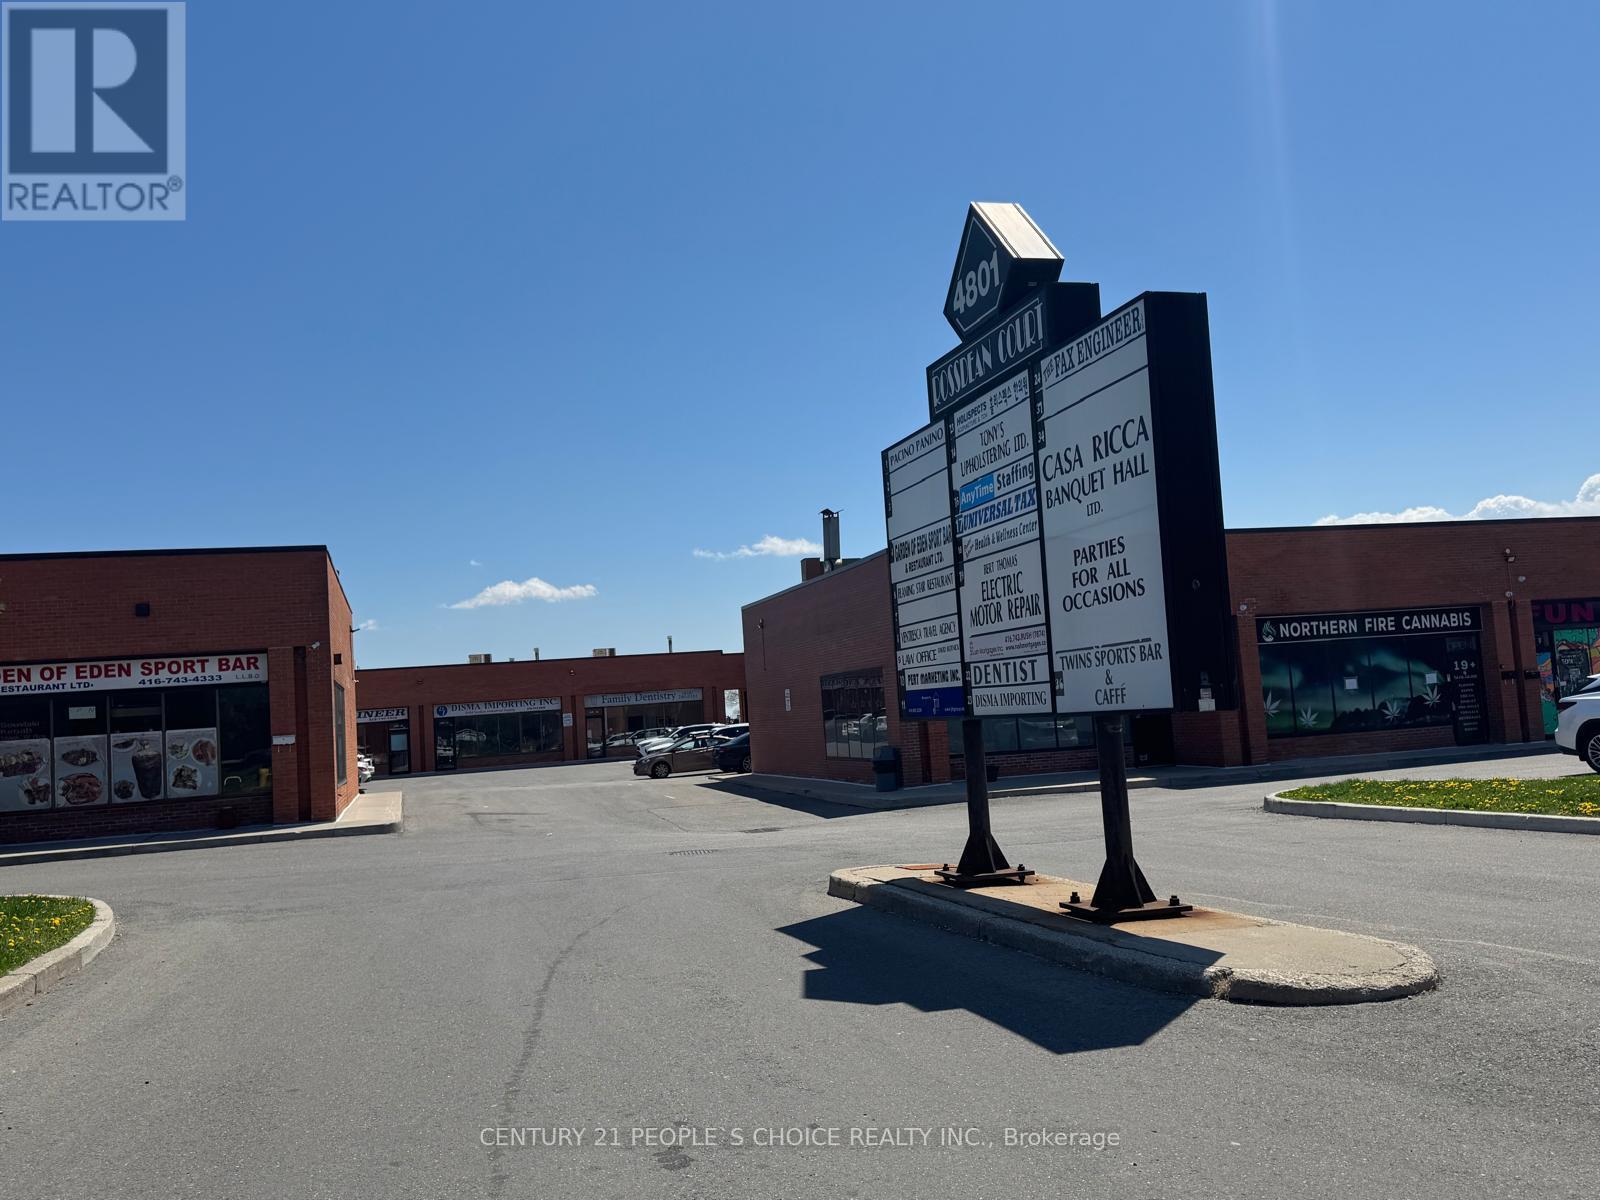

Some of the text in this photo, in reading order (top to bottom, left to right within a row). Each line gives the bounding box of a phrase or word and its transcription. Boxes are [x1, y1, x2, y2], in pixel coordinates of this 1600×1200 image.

[953, 250, 1001, 316] 4801
[932, 301, 1044, 408] ROSSDEAN COURT
[1043, 361, 1055, 382] THE
[1054, 346, 1076, 378] FAX
[1077, 305, 1142, 367] ENGINEER
[956, 403, 987, 426] HOLISPECTS
[890, 427, 944, 466] PACINO PANINO
[980, 421, 1004, 446] TONY'S
[960, 439, 1011, 477] UPHOLSTERING
[1014, 432, 1029, 453] LTD.
[1042, 415, 1150, 482] CASA RICCA
[960, 482, 994, 505] AnyTime
[996, 461, 1034, 490] Staffing
[1046, 452, 1150, 510] BANQUET HALL
[964, 497, 1014, 531] UNIVERSAL
[1014, 487, 1036, 512] TAX
[1086, 500, 1104, 517] LTD.
[974, 533, 990, 551] Health
[992, 532, 996, 544] &
[996, 526, 1018, 542] Wellness
[1019, 520, 1037, 536] Center
[996, 554, 1018, 572] THOMAS
[1073, 535, 1126, 567] PARTIES
[916, 579, 926, 594] STAR
[927, 572, 954, 590] RESTAURANT
[981, 571, 1024, 602] ELECTRIC
[1072, 558, 1132, 589] FOR ALL
[1062, 578, 1145, 613] OCCASIONS
[970, 592, 1042, 628] MOTOR REPAIR
[940, 620, 956, 636] AGENCY
[1280, 612, 1472, 638] NORTHERN FIRE CANNABIS
[0, 656, 260, 684] EN OF EDEN SPORT BAR
[902, 652, 915, 666] LAW
[916, 649, 937, 664] OFFICE
[1060, 642, 1163, 672] TWINS SPORTS BAR
[1454, 660, 1476, 670] 19+
[70, 681, 94, 689] LTD.
[138, 674, 222, 685] 416-743-4333
[908, 673, 919, 686] PERT
[920, 670, 949, 684] MARKETING
[973, 658, 1038, 686] DENTIST
[1105, 669, 1113, 686] &
[451, 702, 480, 712] DISMA
[484, 698, 536, 710] IMPORTING
[602, 694, 632, 704] Family
[634, 691, 676, 702] Dentistry
[976, 693, 998, 708] DISMA
[1000, 690, 1047, 706] IMPORTING
